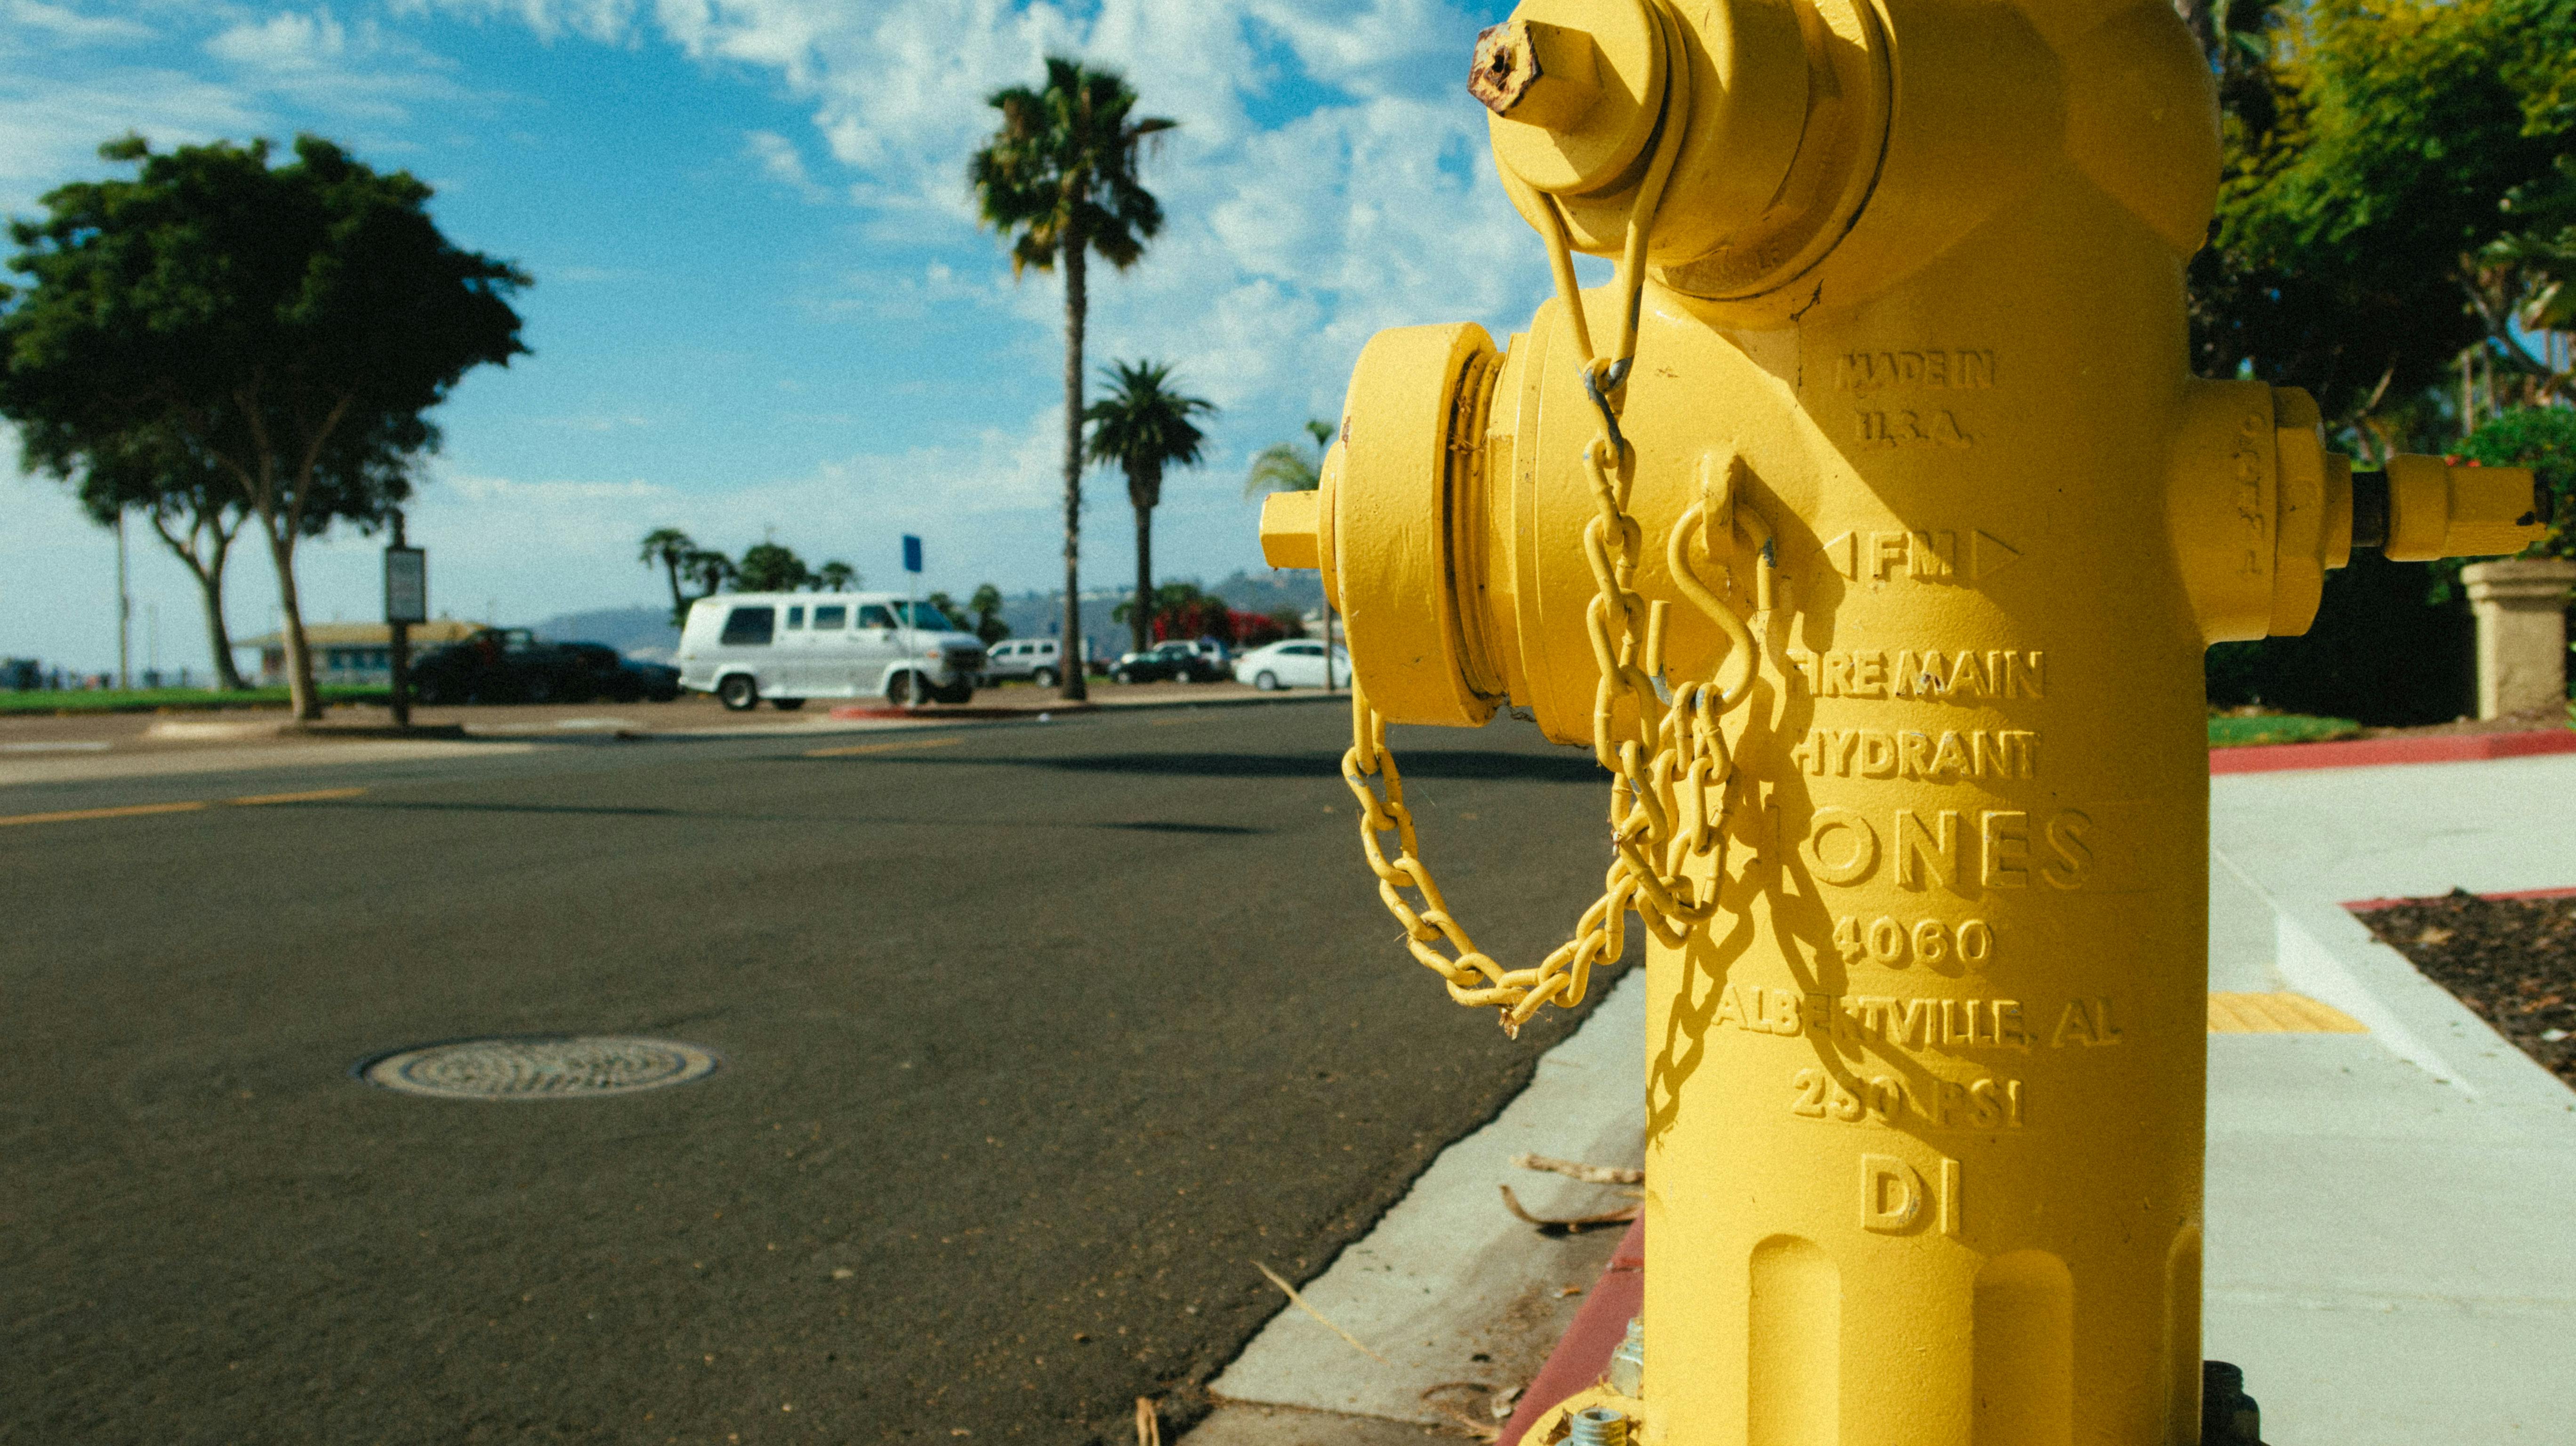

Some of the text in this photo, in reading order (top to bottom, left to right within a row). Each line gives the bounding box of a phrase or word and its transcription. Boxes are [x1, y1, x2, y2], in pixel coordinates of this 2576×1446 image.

[1835, 349, 1996, 389] MADE IN
[1869, 530, 1958, 578] FM
[1893, 649, 2044, 699] MAIN
[1790, 729, 2040, 779] HYDRANT
[1832, 915, 1994, 966] 4060
[2050, 998, 2122, 1048] AL
[1932, 1078, 2025, 1128] PSI
[1860, 1152, 1962, 1236] DI
